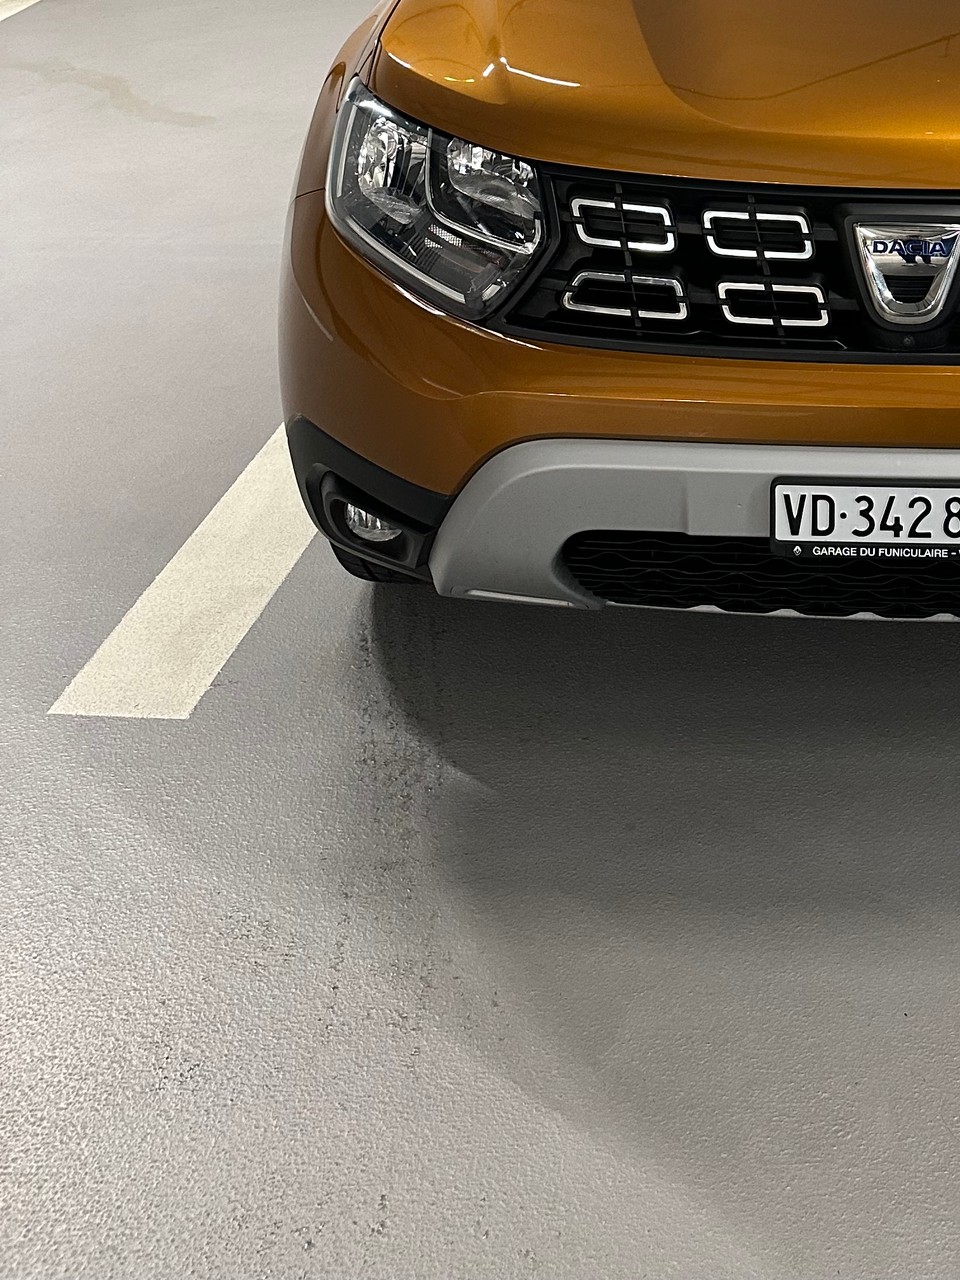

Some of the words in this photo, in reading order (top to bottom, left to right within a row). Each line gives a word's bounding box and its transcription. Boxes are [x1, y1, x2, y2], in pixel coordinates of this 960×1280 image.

[872, 239, 947, 258] DACIA
[812, 546, 858, 557] GARAGE
[860, 547, 876, 557] DU
[878, 547, 949, 558] FUNICULAIRE
